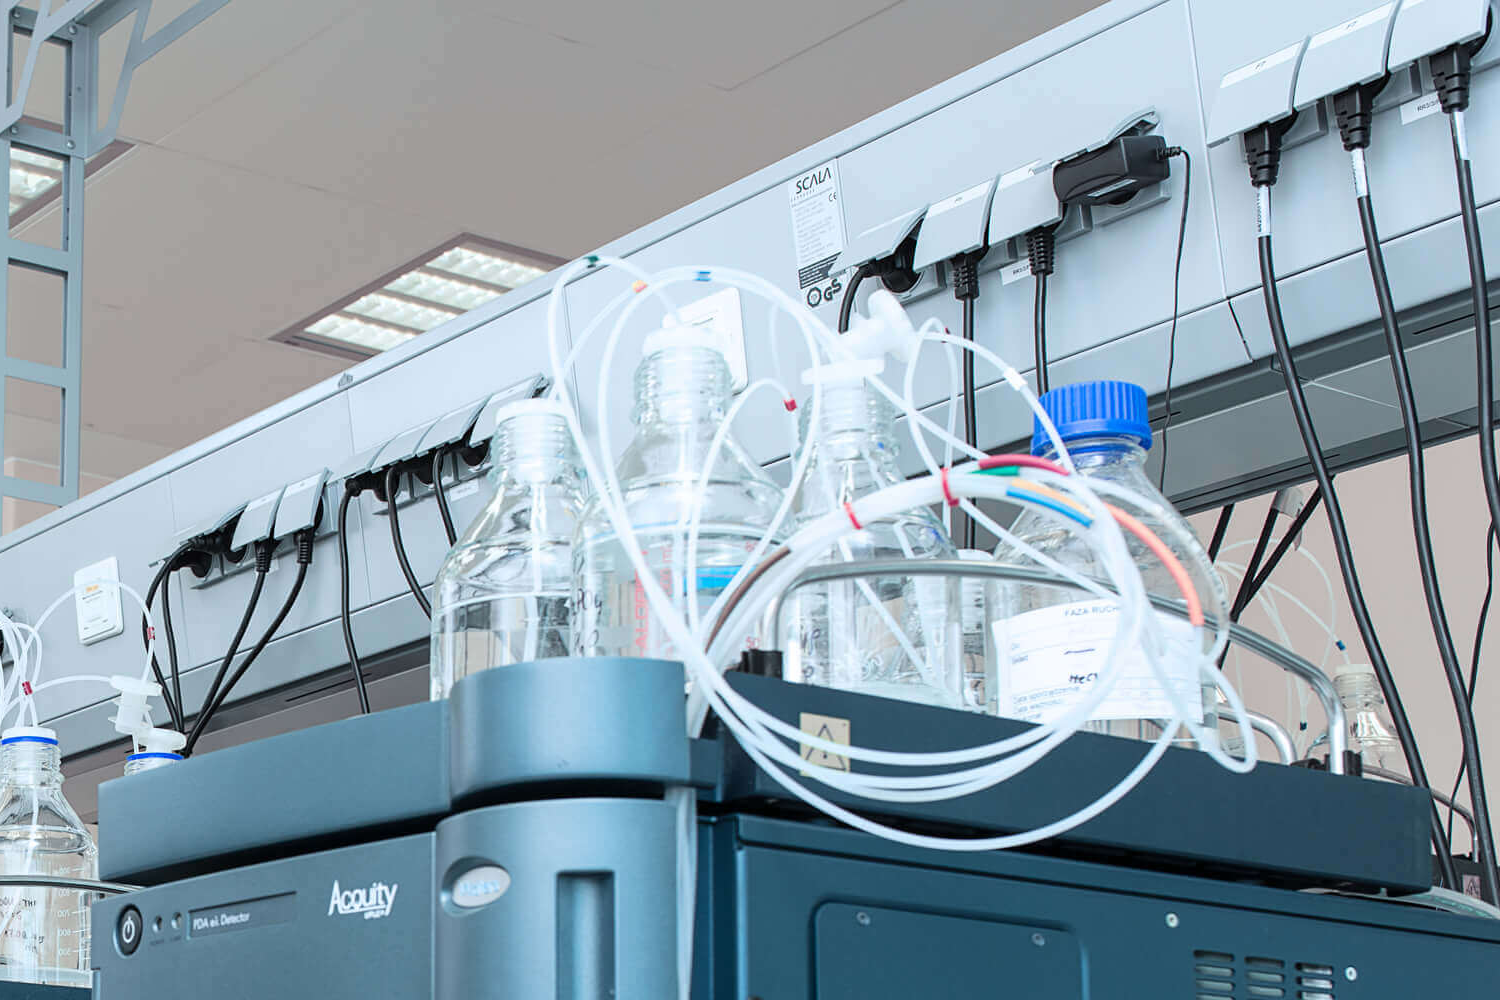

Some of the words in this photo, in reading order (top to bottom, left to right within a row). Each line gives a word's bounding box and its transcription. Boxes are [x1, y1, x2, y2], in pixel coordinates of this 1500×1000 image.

[795, 167, 831, 194] SCALA
[824, 278, 842, 301] GS
[328, 879, 398, 917] Acquity
[193, 917, 208, 930] PDA
[221, 912, 250, 926] Detector
